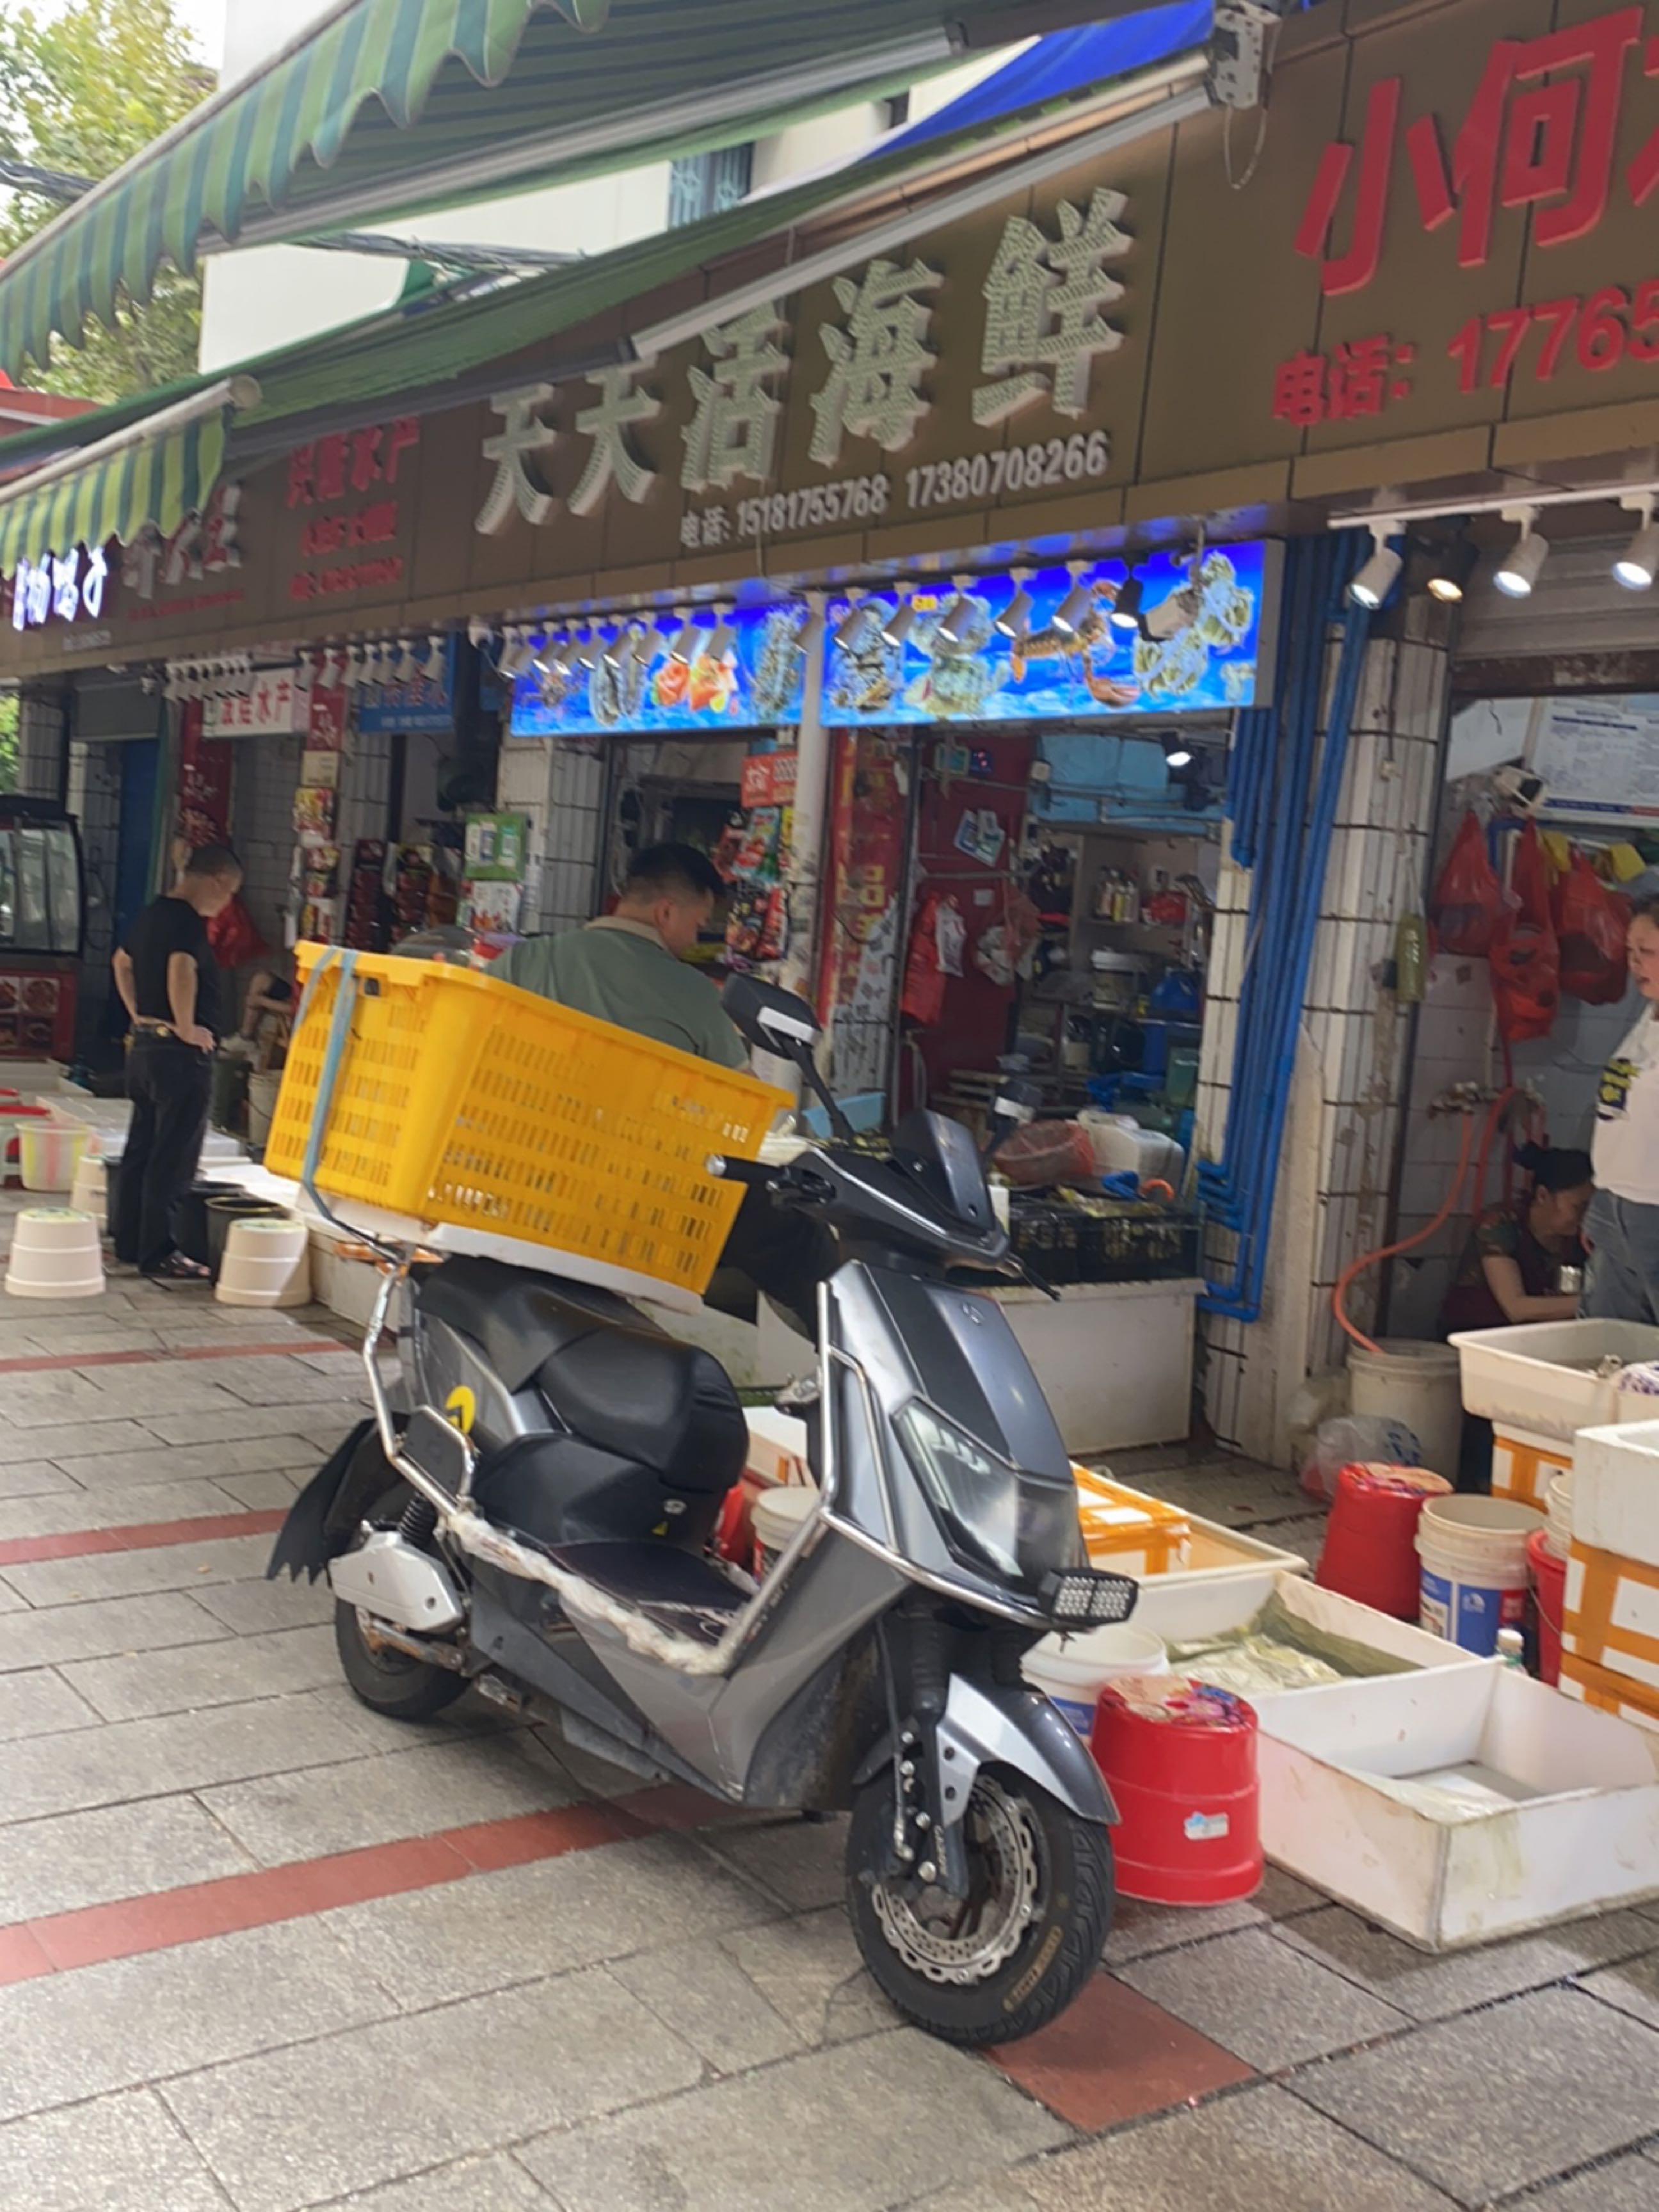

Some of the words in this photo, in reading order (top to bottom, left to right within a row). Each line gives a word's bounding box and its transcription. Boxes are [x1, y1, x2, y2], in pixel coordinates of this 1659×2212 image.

[474, 187, 1134, 535] 天天活海鲜
[905, 429, 1109, 509] 17380708266
